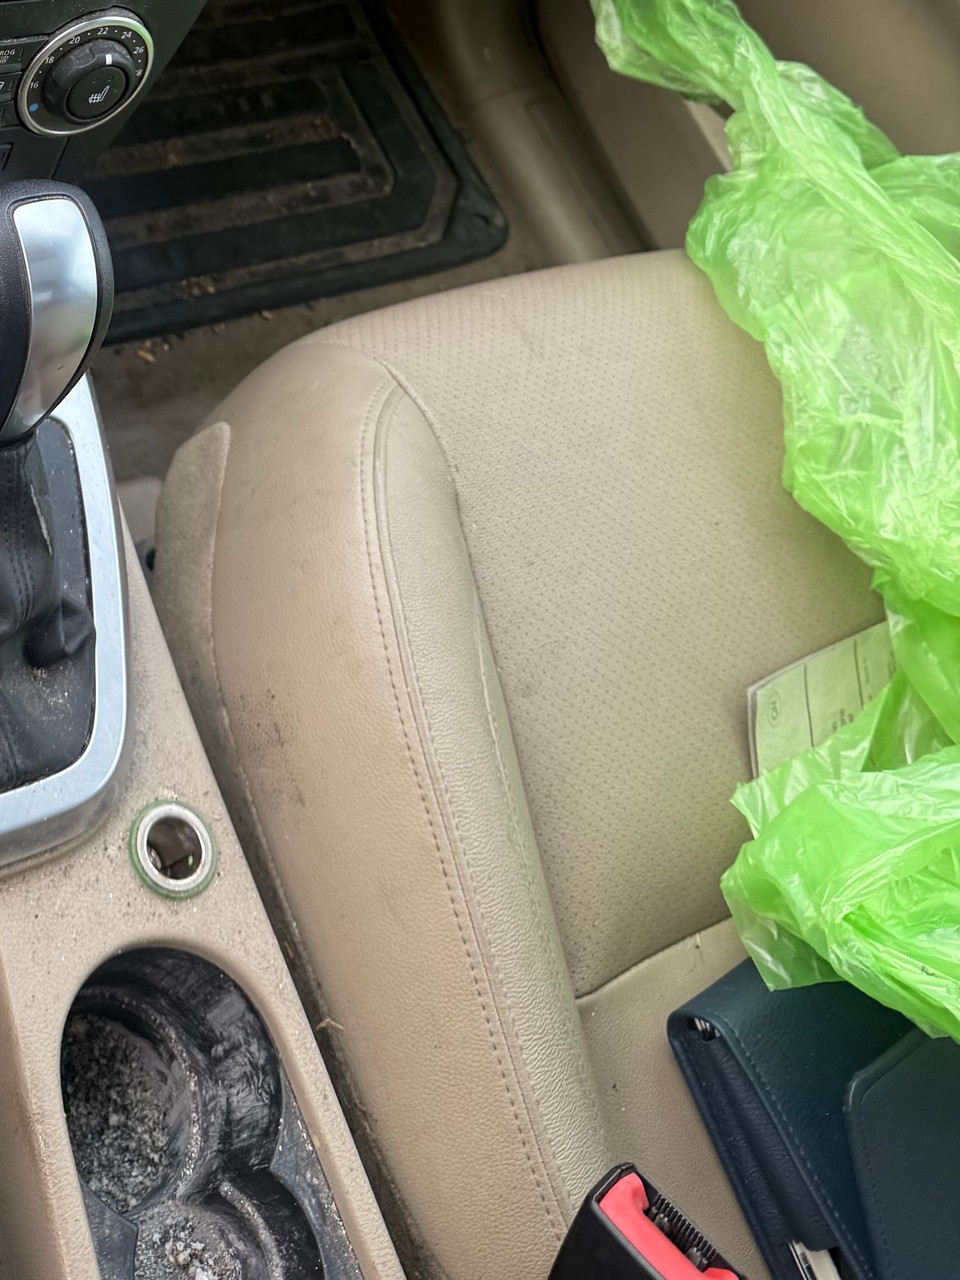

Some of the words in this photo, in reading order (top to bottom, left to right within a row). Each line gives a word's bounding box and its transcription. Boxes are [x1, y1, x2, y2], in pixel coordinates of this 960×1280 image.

[97, 27, 109, 35] 22
[121, 31, 132, 39] 24
[69, 36, 81, 45] 20
[133, 46, 145, 54] 26
[45, 56, 55, 64] 18
[29, 80, 39, 89] 16
